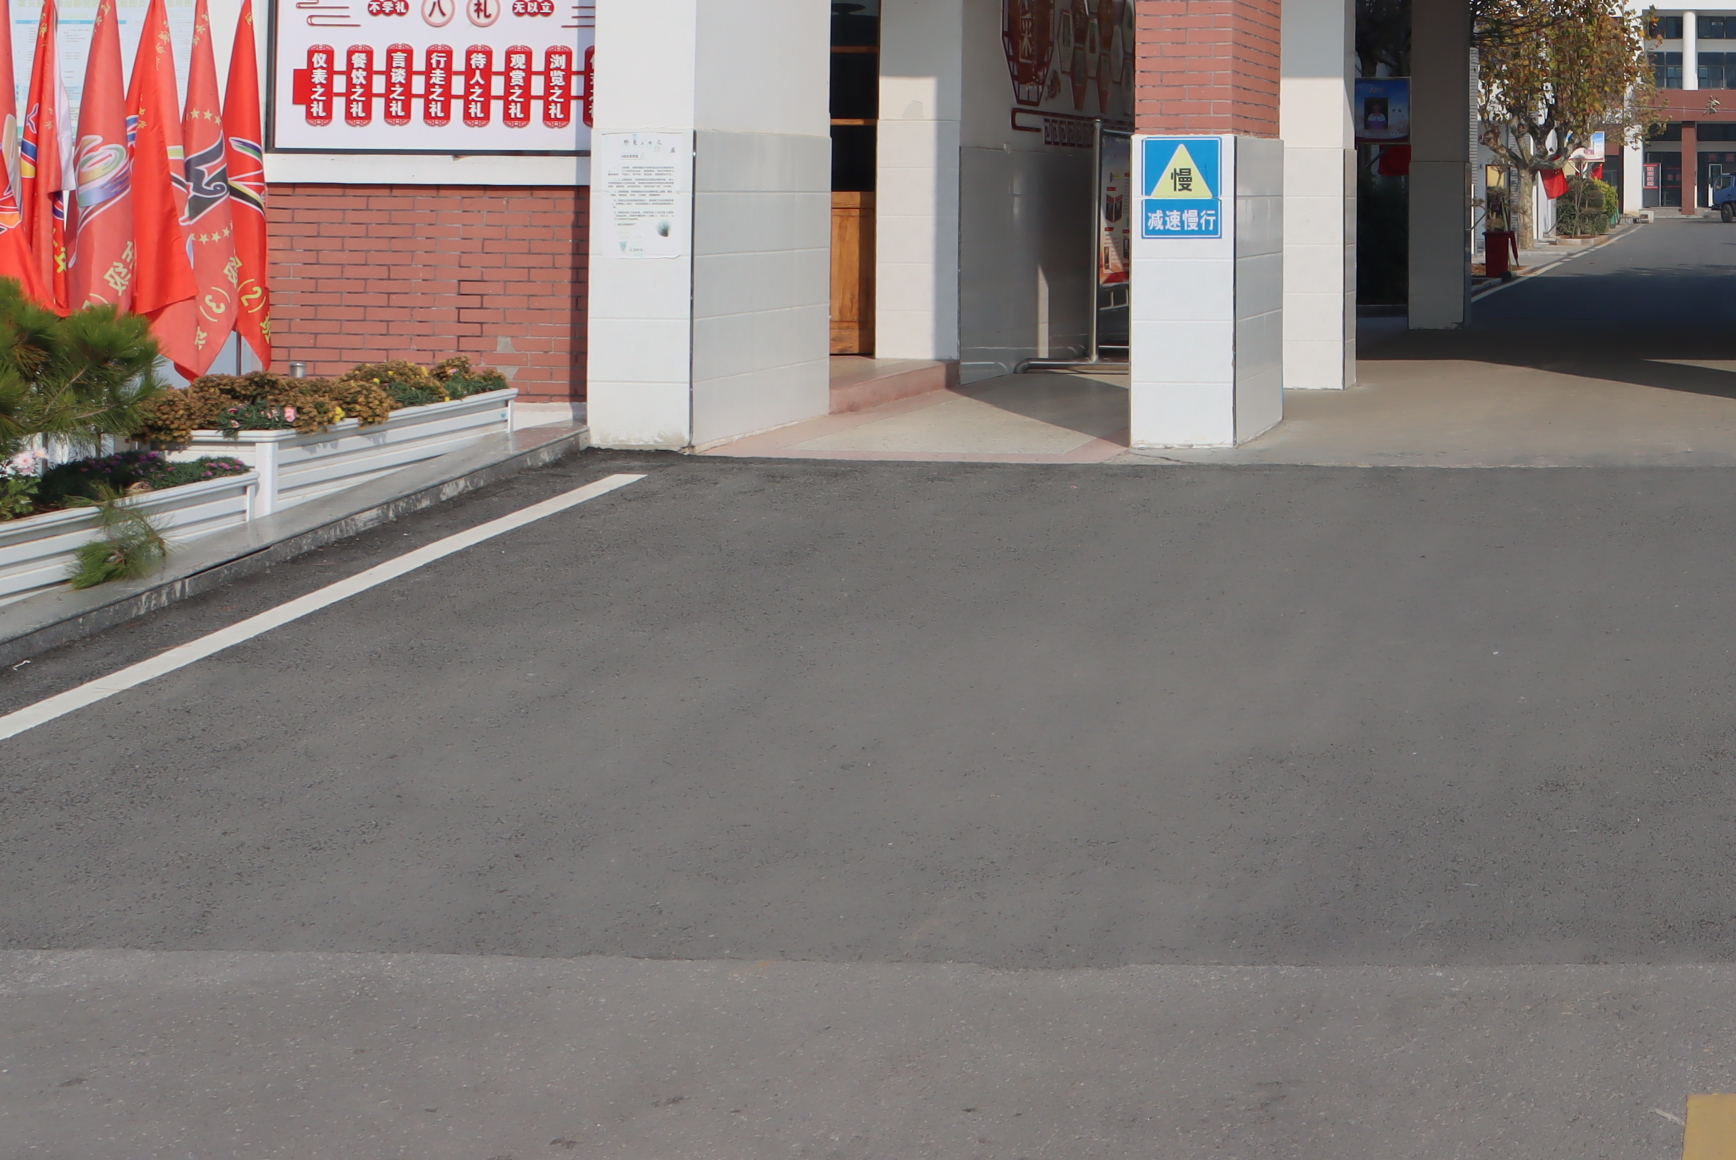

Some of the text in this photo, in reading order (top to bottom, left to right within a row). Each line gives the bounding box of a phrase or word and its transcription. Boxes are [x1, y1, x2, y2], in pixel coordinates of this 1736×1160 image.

[369, 0, 552, 19] 不学礼 八 礼 无以立
[310, 52, 328, 117] 仪表之礼
[349, 52, 367, 117] 餐饮之礼
[389, 52, 407, 116] 言谈之礼
[428, 52, 447, 117] 行走之礼
[468, 53, 487, 117] 待人之礼
[508, 53, 526, 118] 观赏之礼
[548, 54, 566, 119] 浏览之礼
[1170, 168, 1193, 191] 慢
[1147, 209, 1217, 231] 减速慢行
